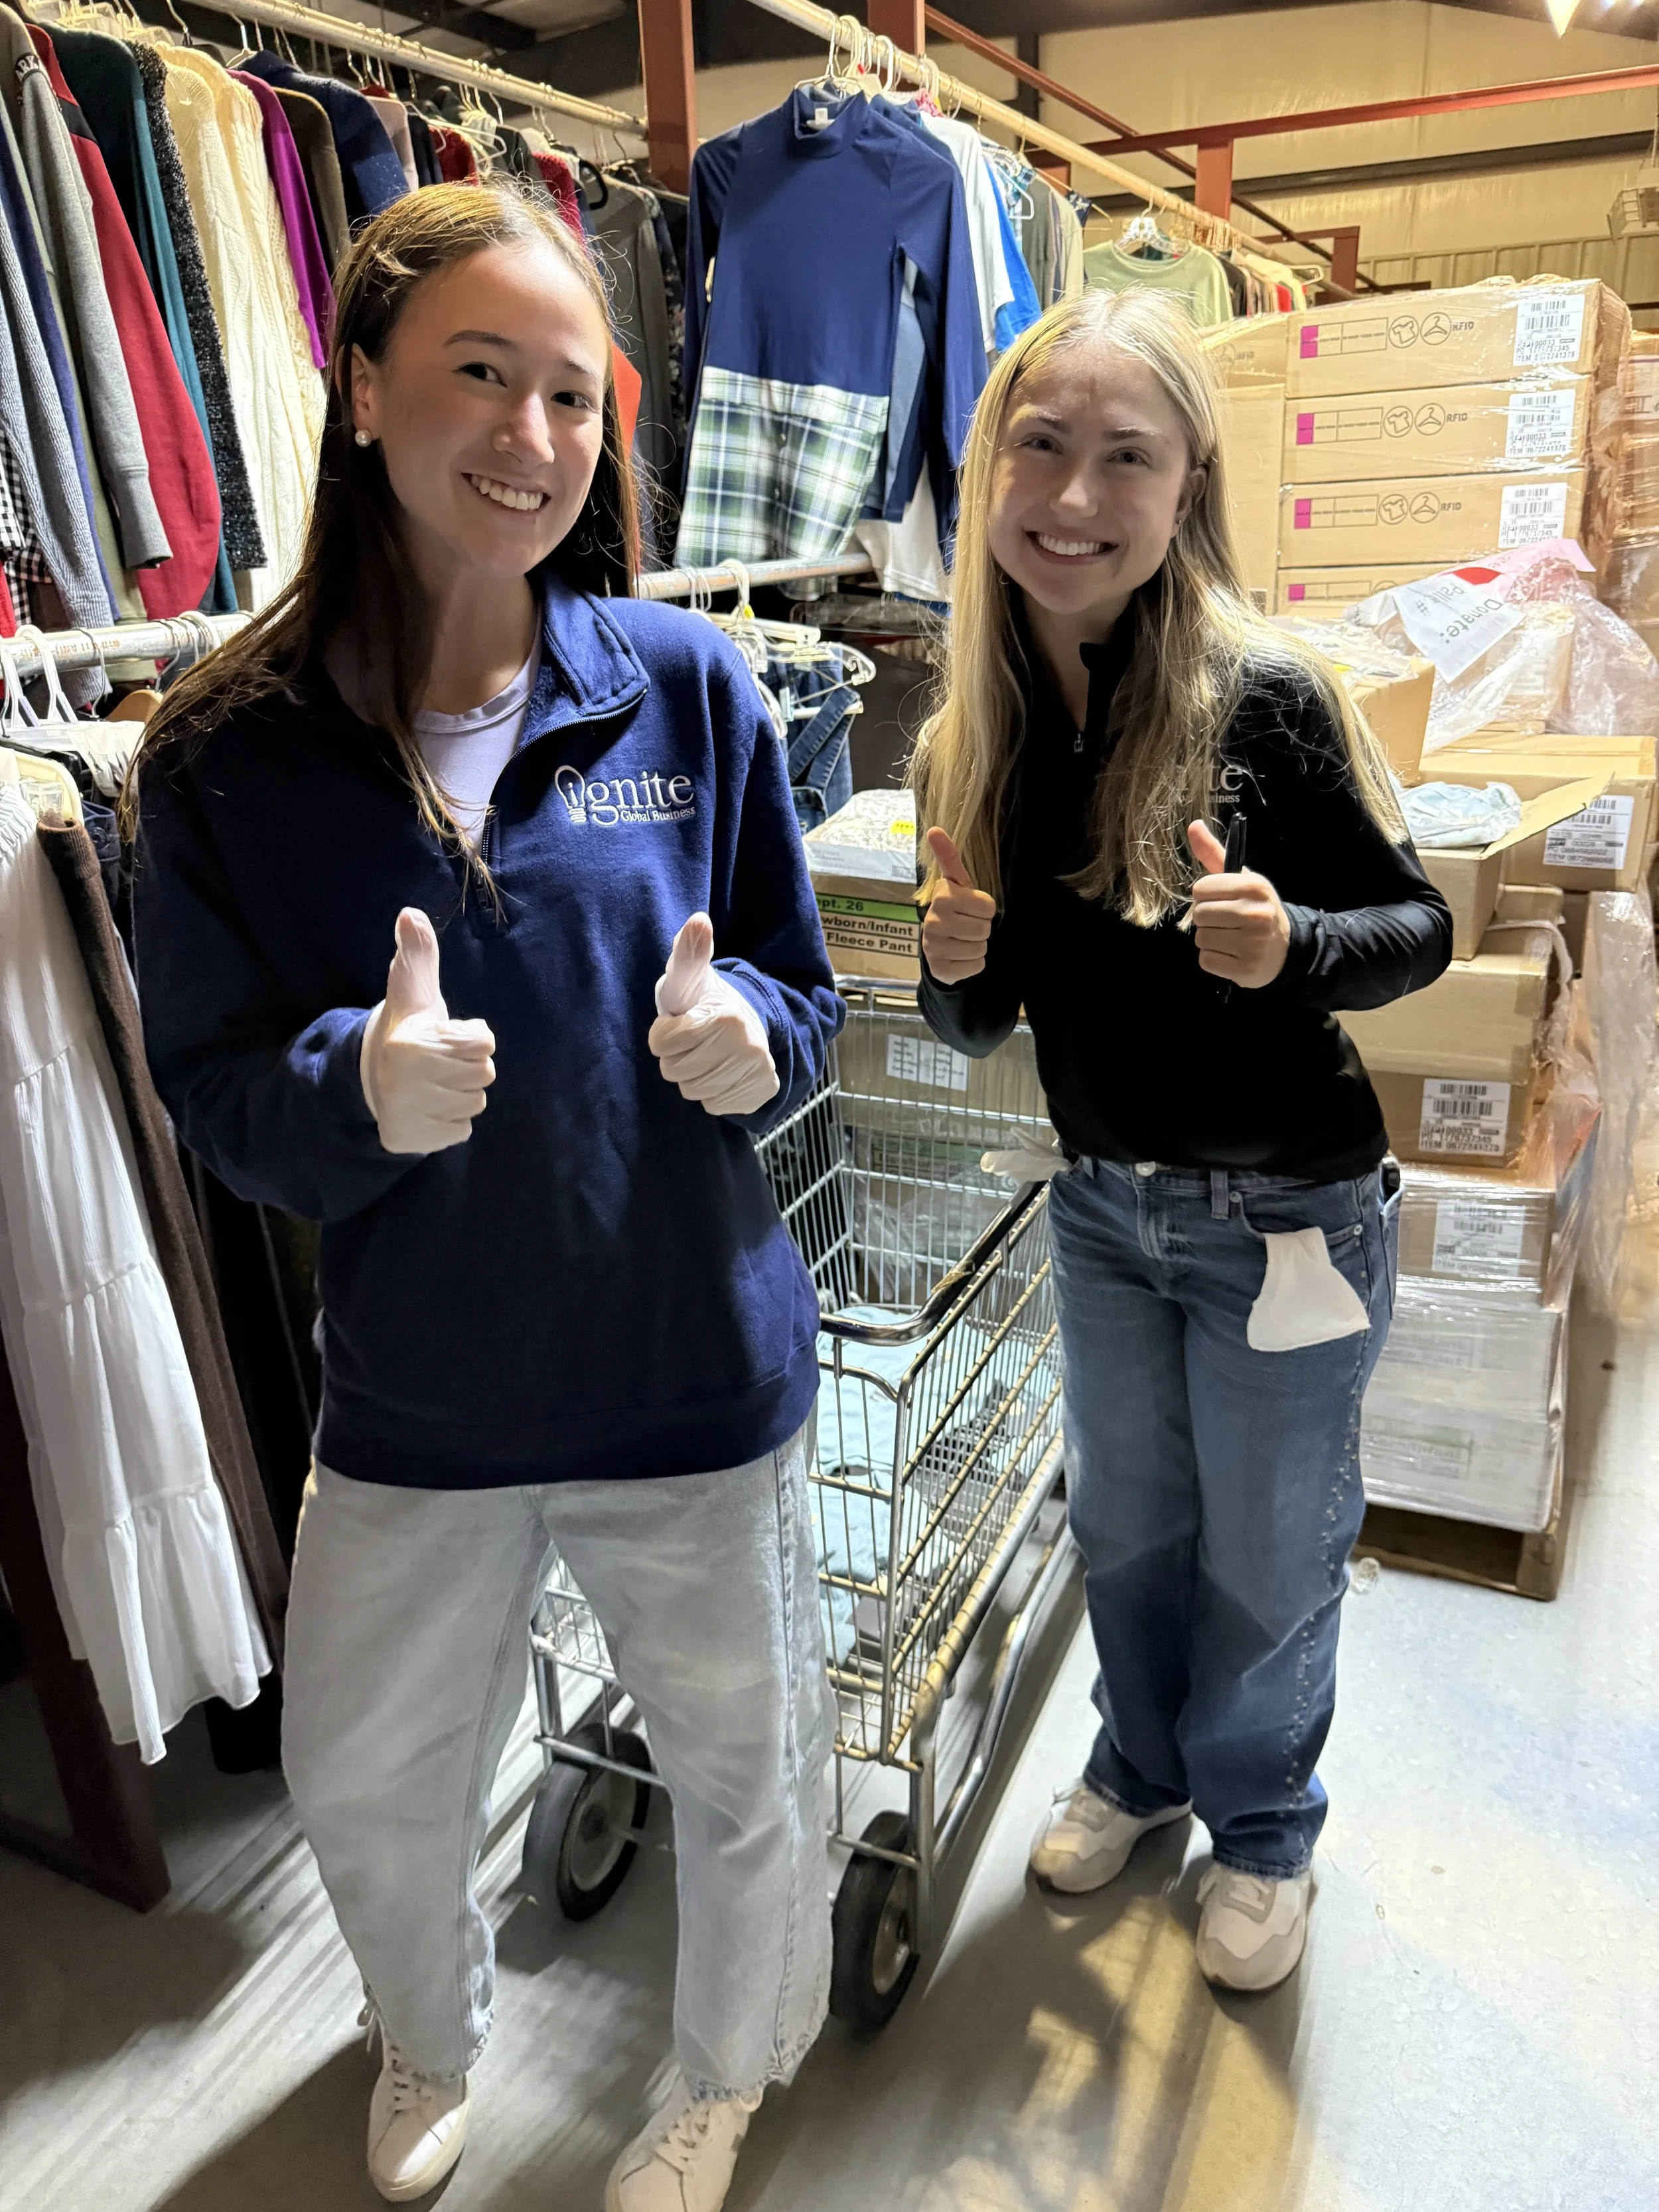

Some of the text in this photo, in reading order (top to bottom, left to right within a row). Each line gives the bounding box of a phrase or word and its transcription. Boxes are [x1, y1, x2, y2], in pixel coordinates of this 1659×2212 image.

[1447, 413, 1468, 422] RFID
[1441, 502, 1462, 511] RFID
[1439, 598, 1504, 644] Donate:
[620, 806, 696, 822] Global Business
[846, 900, 864, 911] 26
[821, 916, 914, 936] wborn/Infant
[826, 932, 913, 953] Fleece Pant
